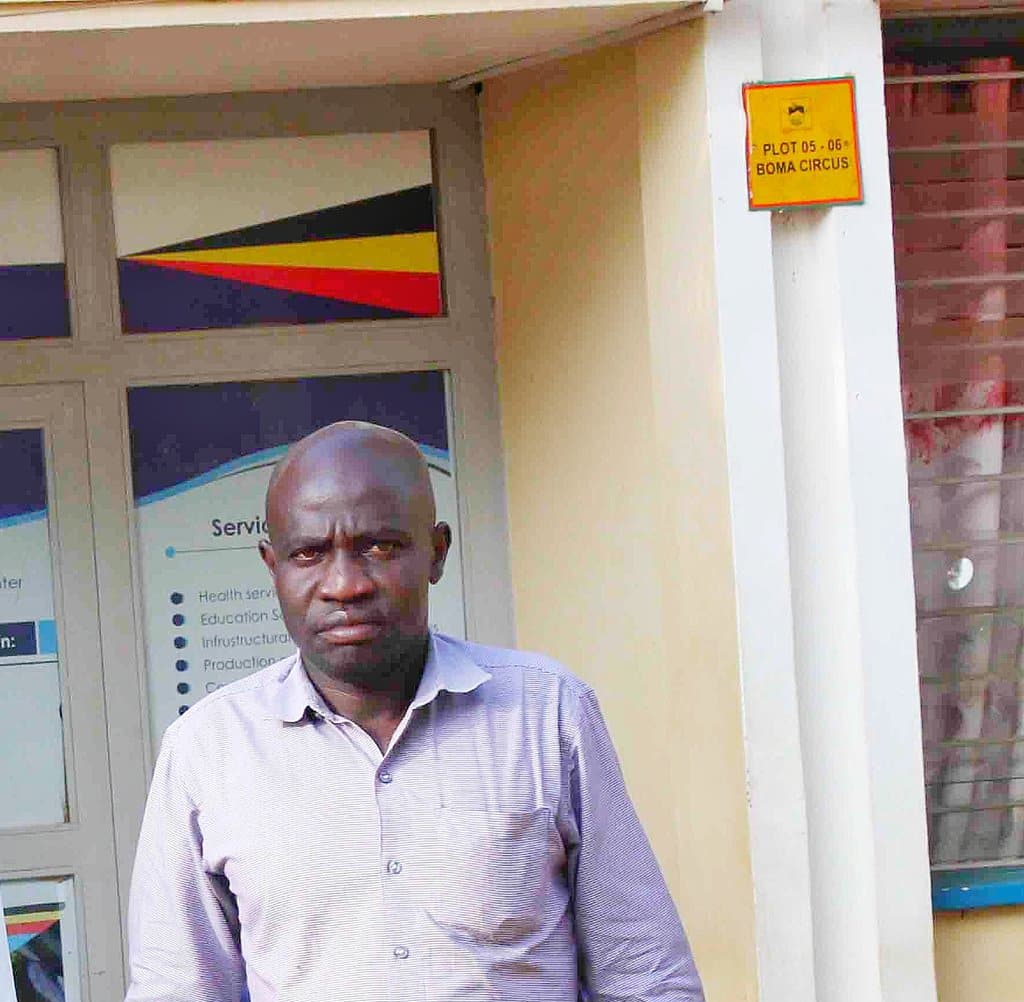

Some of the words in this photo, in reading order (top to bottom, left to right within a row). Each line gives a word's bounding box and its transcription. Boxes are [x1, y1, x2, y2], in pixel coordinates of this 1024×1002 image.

[763, 141, 797, 156] PLOT
[801, 140, 816, 153] 05
[827, 138, 842, 151] 06
[756, 161, 796, 176] BOMA
[799, 157, 849, 172] CIRCUS
[198, 588, 243, 603] Health
[201, 609, 268, 626] Education
